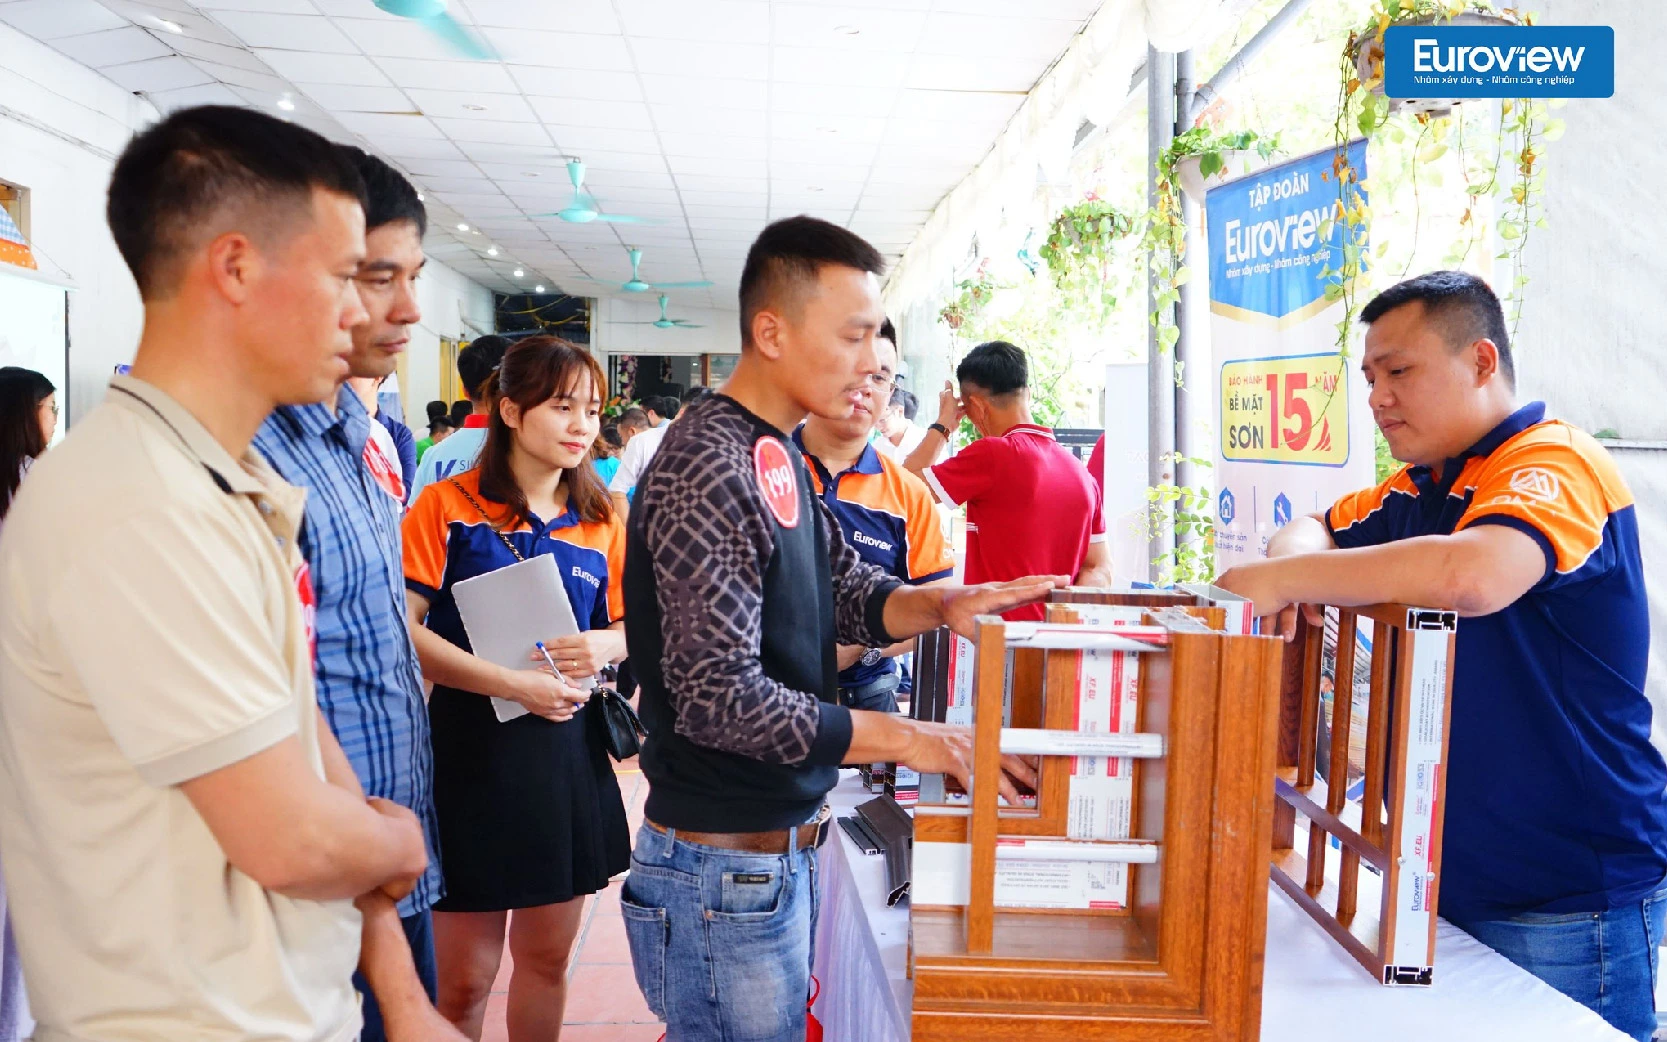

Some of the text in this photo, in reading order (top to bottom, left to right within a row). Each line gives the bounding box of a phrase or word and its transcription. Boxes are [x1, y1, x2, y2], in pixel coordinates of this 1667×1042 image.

[1249, 171, 1310, 211] TẬP ĐOÀN
[1225, 203, 1337, 264] Euroview
[1242, 393, 1263, 415] MẶT
[1266, 372, 1312, 451] 15
[1229, 421, 1264, 449] SƠN
[765, 465, 793, 498] 199
